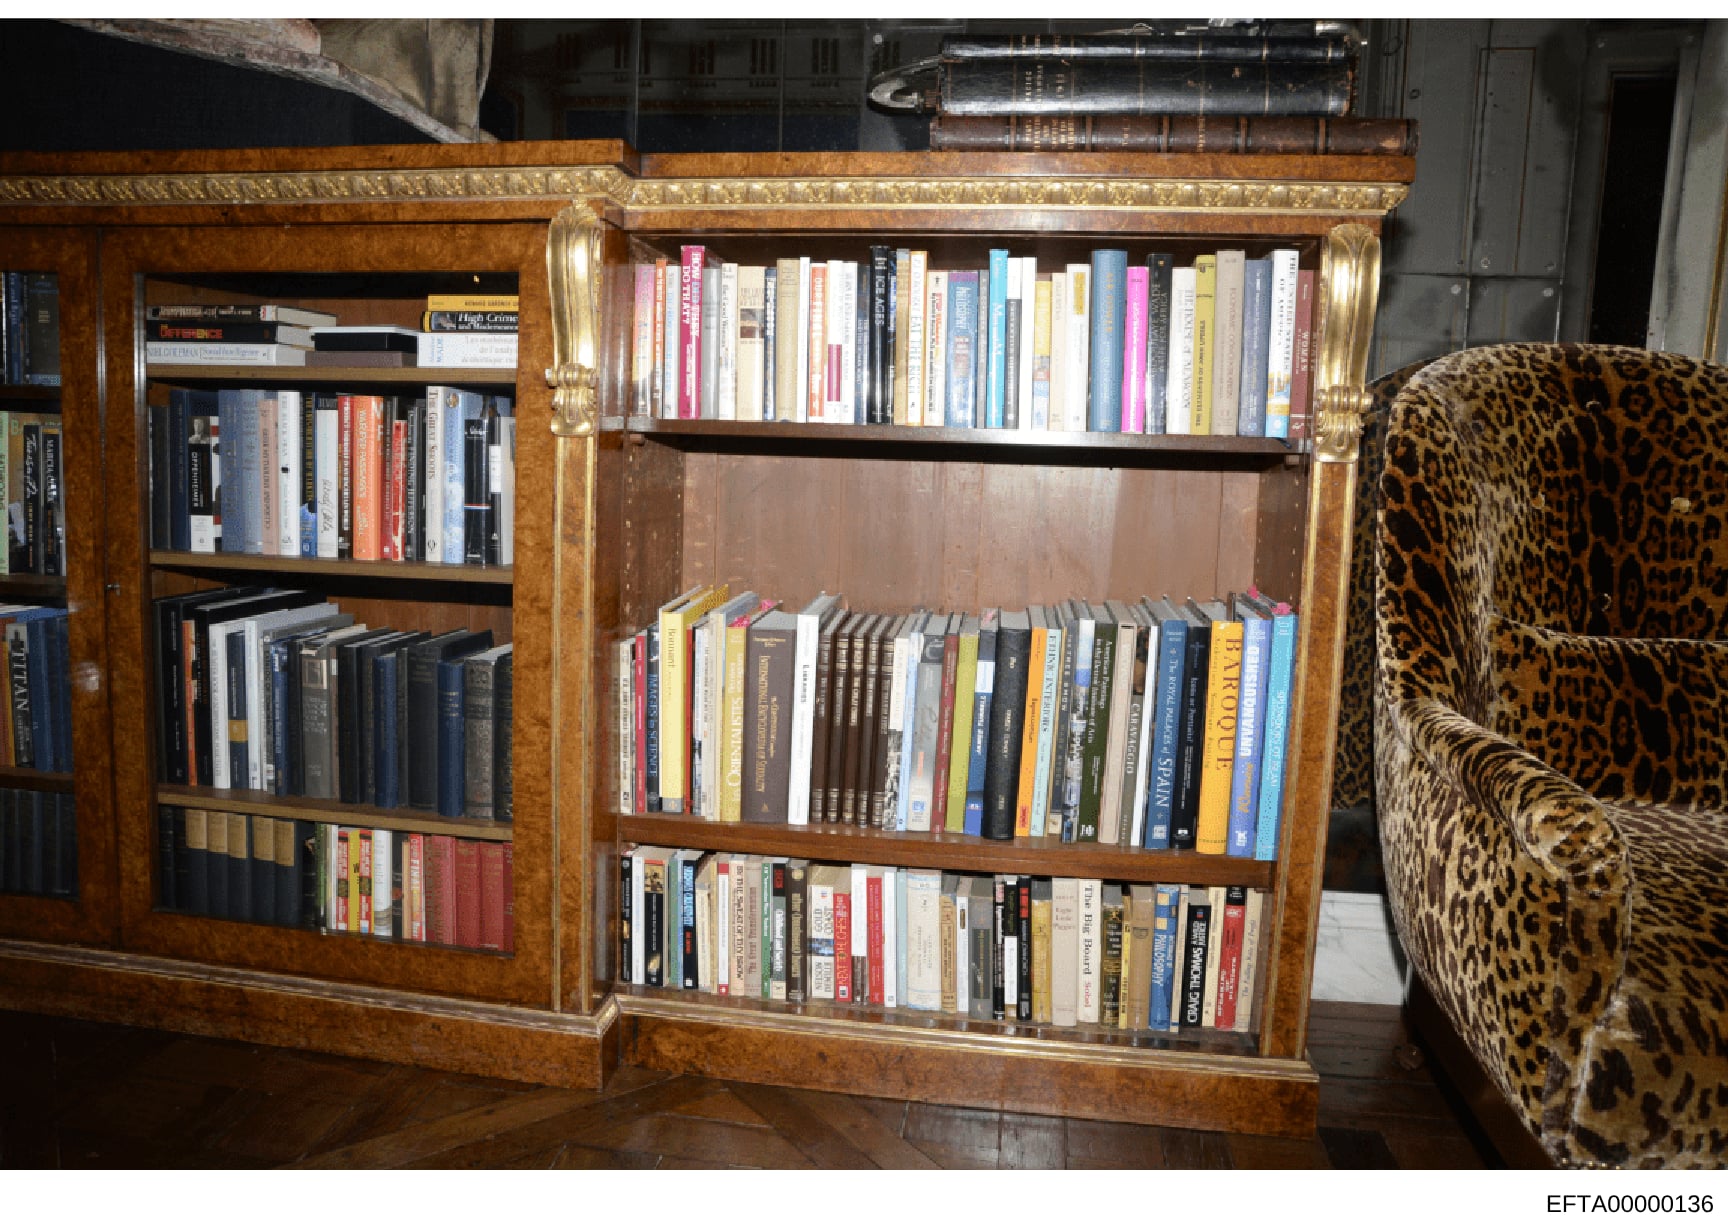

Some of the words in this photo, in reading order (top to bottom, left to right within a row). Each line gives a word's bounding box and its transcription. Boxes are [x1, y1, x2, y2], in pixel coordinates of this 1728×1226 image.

[682, 266, 691, 283] DO
[691, 252, 701, 280] HOW
[1288, 255, 1297, 278] THE
[691, 281, 700, 304] DID
[875, 275, 885, 294] ICE
[1151, 284, 1161, 313] WADE
[458, 312, 484, 325] High
[682, 284, 690, 325] THAT?
[812, 301, 823, 336] FINAL
[874, 297, 885, 326] AGES
[1159, 293, 1168, 322] AFRICA
[1226, 287, 1237, 329] ECONOMIC
[690, 304, 700, 337] THEY
[910, 315, 921, 333] EAT
[909, 339, 921, 360] THE
[428, 390, 439, 409] THE
[358, 409, 367, 450] WARPED
[428, 412, 438, 442] GREAT
[191, 451, 199, 508] OPPENHEIMER
[358, 451, 367, 499] PASSAGES
[406, 487, 416, 535] JEFFERSON
[1045, 635, 1057, 676] ETHNIC
[1095, 645, 1103, 658] the
[1102, 640, 1113, 675] American
[1169, 659, 1178, 673] The
[12, 648, 29, 712] TITAN
[758, 655, 771, 703] INTERNATIONAL
[1092, 659, 1102, 686] Detroit
[648, 674, 658, 717] IMAGES
[1041, 676, 1054, 733] INTERIORS
[1099, 676, 1111, 709] Paintings
[1165, 676, 1177, 705] ROYAL
[1215, 638, 1242, 771] BAROQUE
[1239, 646, 1260, 757] UNVANQUISHED
[1126, 703, 1141, 775] CARAVAGGIO
[1162, 707, 1173, 745] PALACES
[648, 730, 658, 778] SCIENCE
[1154, 757, 1173, 807] SPAIN
[411, 859, 420, 890] FINAL
[1084, 884, 1093, 909] The
[736, 925, 743, 935] OF
[814, 909, 823, 933] GOLD
[824, 907, 833, 936] COAST
[1081, 913, 1092, 935] Big
[1198, 921, 1206, 946] JUSTICE
[775, 939, 784, 951] and
[1082, 938, 1093, 976] Board
[1153, 934, 1167, 987] PHILOSOPHY
[814, 962, 823, 991] NELSON
[823, 962, 832, 993] DEMILLE
[1189, 947, 1204, 990] THOMAS
[1187, 992, 1199, 1023] CRAIG
